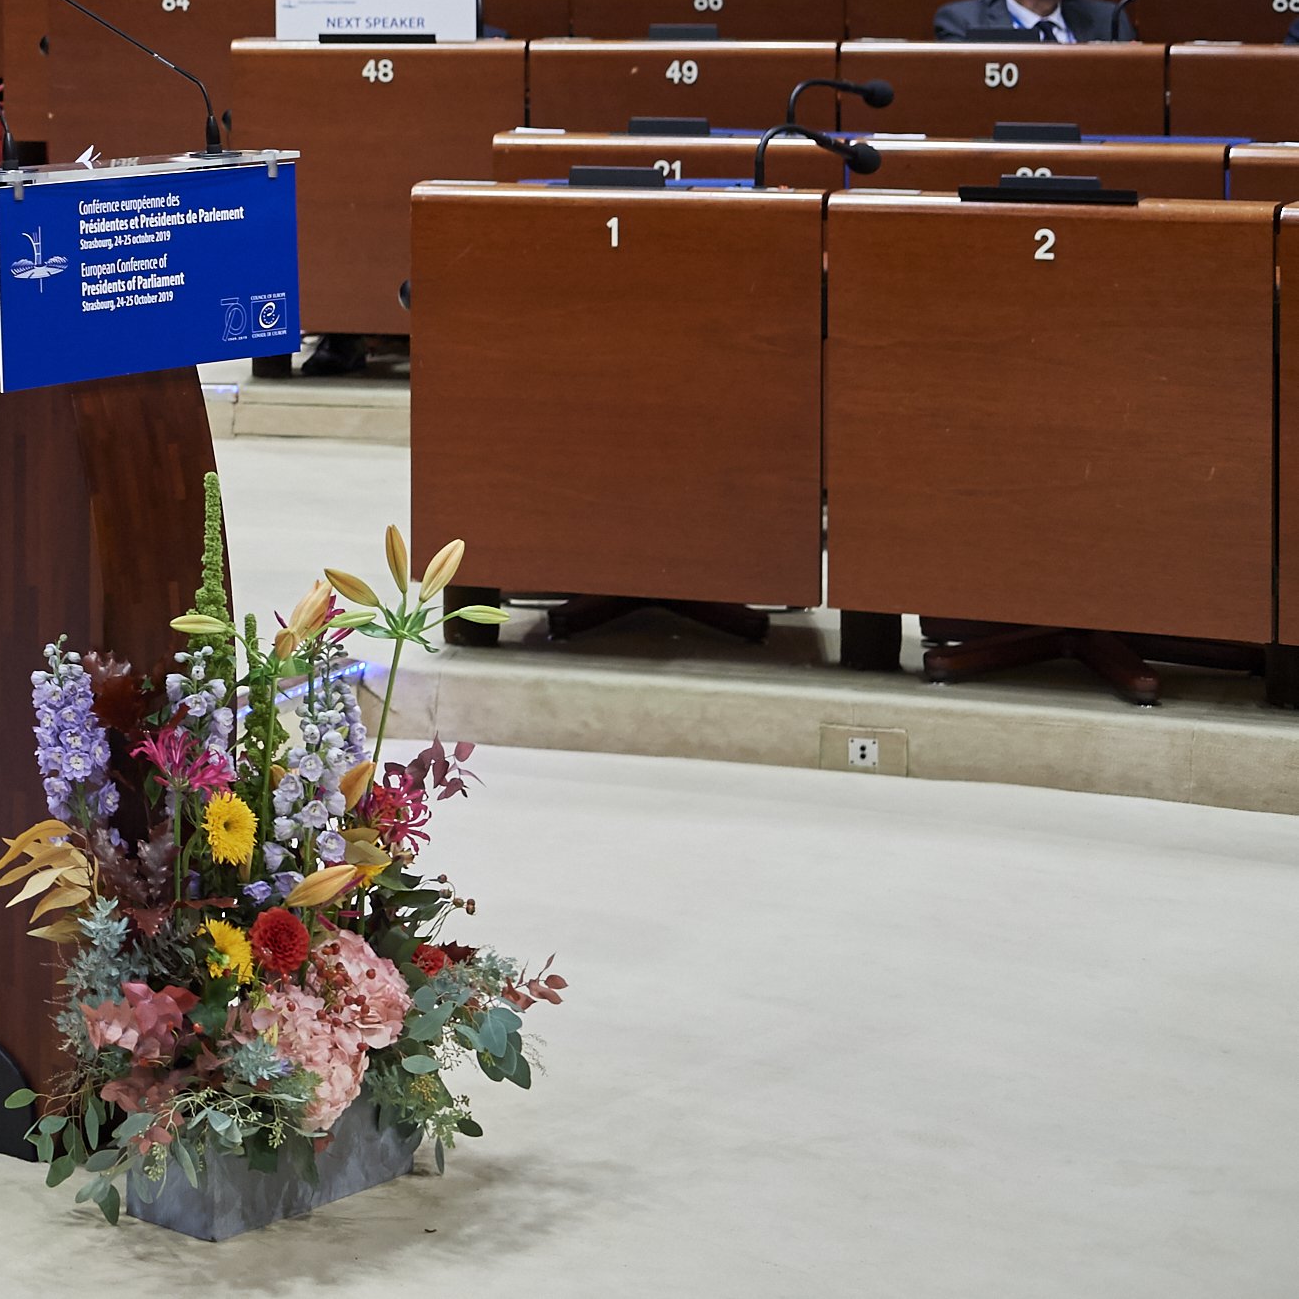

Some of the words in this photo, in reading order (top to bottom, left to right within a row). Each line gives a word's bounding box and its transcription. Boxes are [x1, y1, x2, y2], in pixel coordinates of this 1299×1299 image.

[326, 17, 362, 29] NEXT
[365, 17, 425, 29] SPEAKER
[361, 59, 395, 84] 48
[665, 60, 699, 85] 49
[984, 62, 1019, 89] 50
[79, 198, 120, 215] Conférence
[121, 195, 165, 212] européenne
[166, 193, 180, 207] des
[79, 216, 129, 235] Présidentes
[129, 216, 139, 230] et
[140, 211, 185, 229] Présidents
[186, 209, 198, 224] de
[198, 206, 244, 223] Parlement
[606, 217, 620, 247] 1
[80, 237, 113, 250] Strasbourg,
[114, 234, 132, 247] 24-25
[132, 231, 155, 244] octobre
[155, 230, 171, 242] 2019
[1034, 228, 1056, 260] 2
[81, 259, 116, 278] European
[116, 256, 158, 273] Conference
[159, 253, 168, 268] of
[81, 278, 126, 297] Presidents
[126, 276, 137, 292] of
[137, 272, 185, 290] Parliament
[82, 298, 116, 312] Strasbourg,
[116, 296, 134, 308] 24-25
[134, 293, 158, 306] October
[158, 291, 174, 303] 2019
